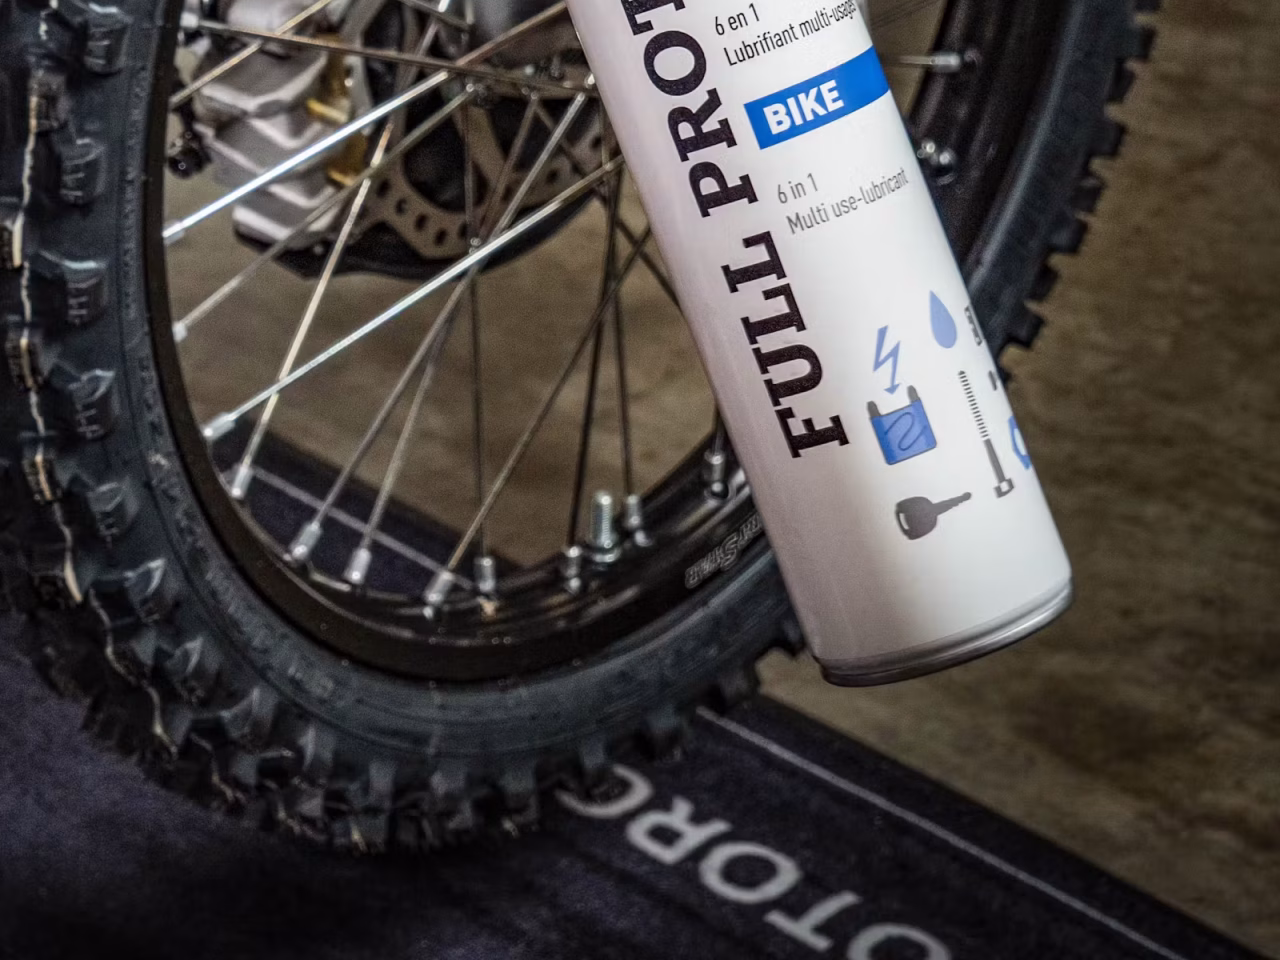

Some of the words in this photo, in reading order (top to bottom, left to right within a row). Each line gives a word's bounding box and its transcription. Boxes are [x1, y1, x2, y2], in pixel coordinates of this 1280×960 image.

[714, 16, 725, 36] 6
[727, 10, 749, 31] en
[748, 2, 760, 22] 1
[723, 24, 799, 67] Lubrifiant
[762, 79, 845, 135] BIKE
[777, 184, 788, 204] 6
[788, 180, 807, 200] in
[806, 172, 818, 192] 1
[785, 202, 830, 235] Multi
[830, 167, 909, 218] use-lubricant
[721, 230, 850, 458] FULL
